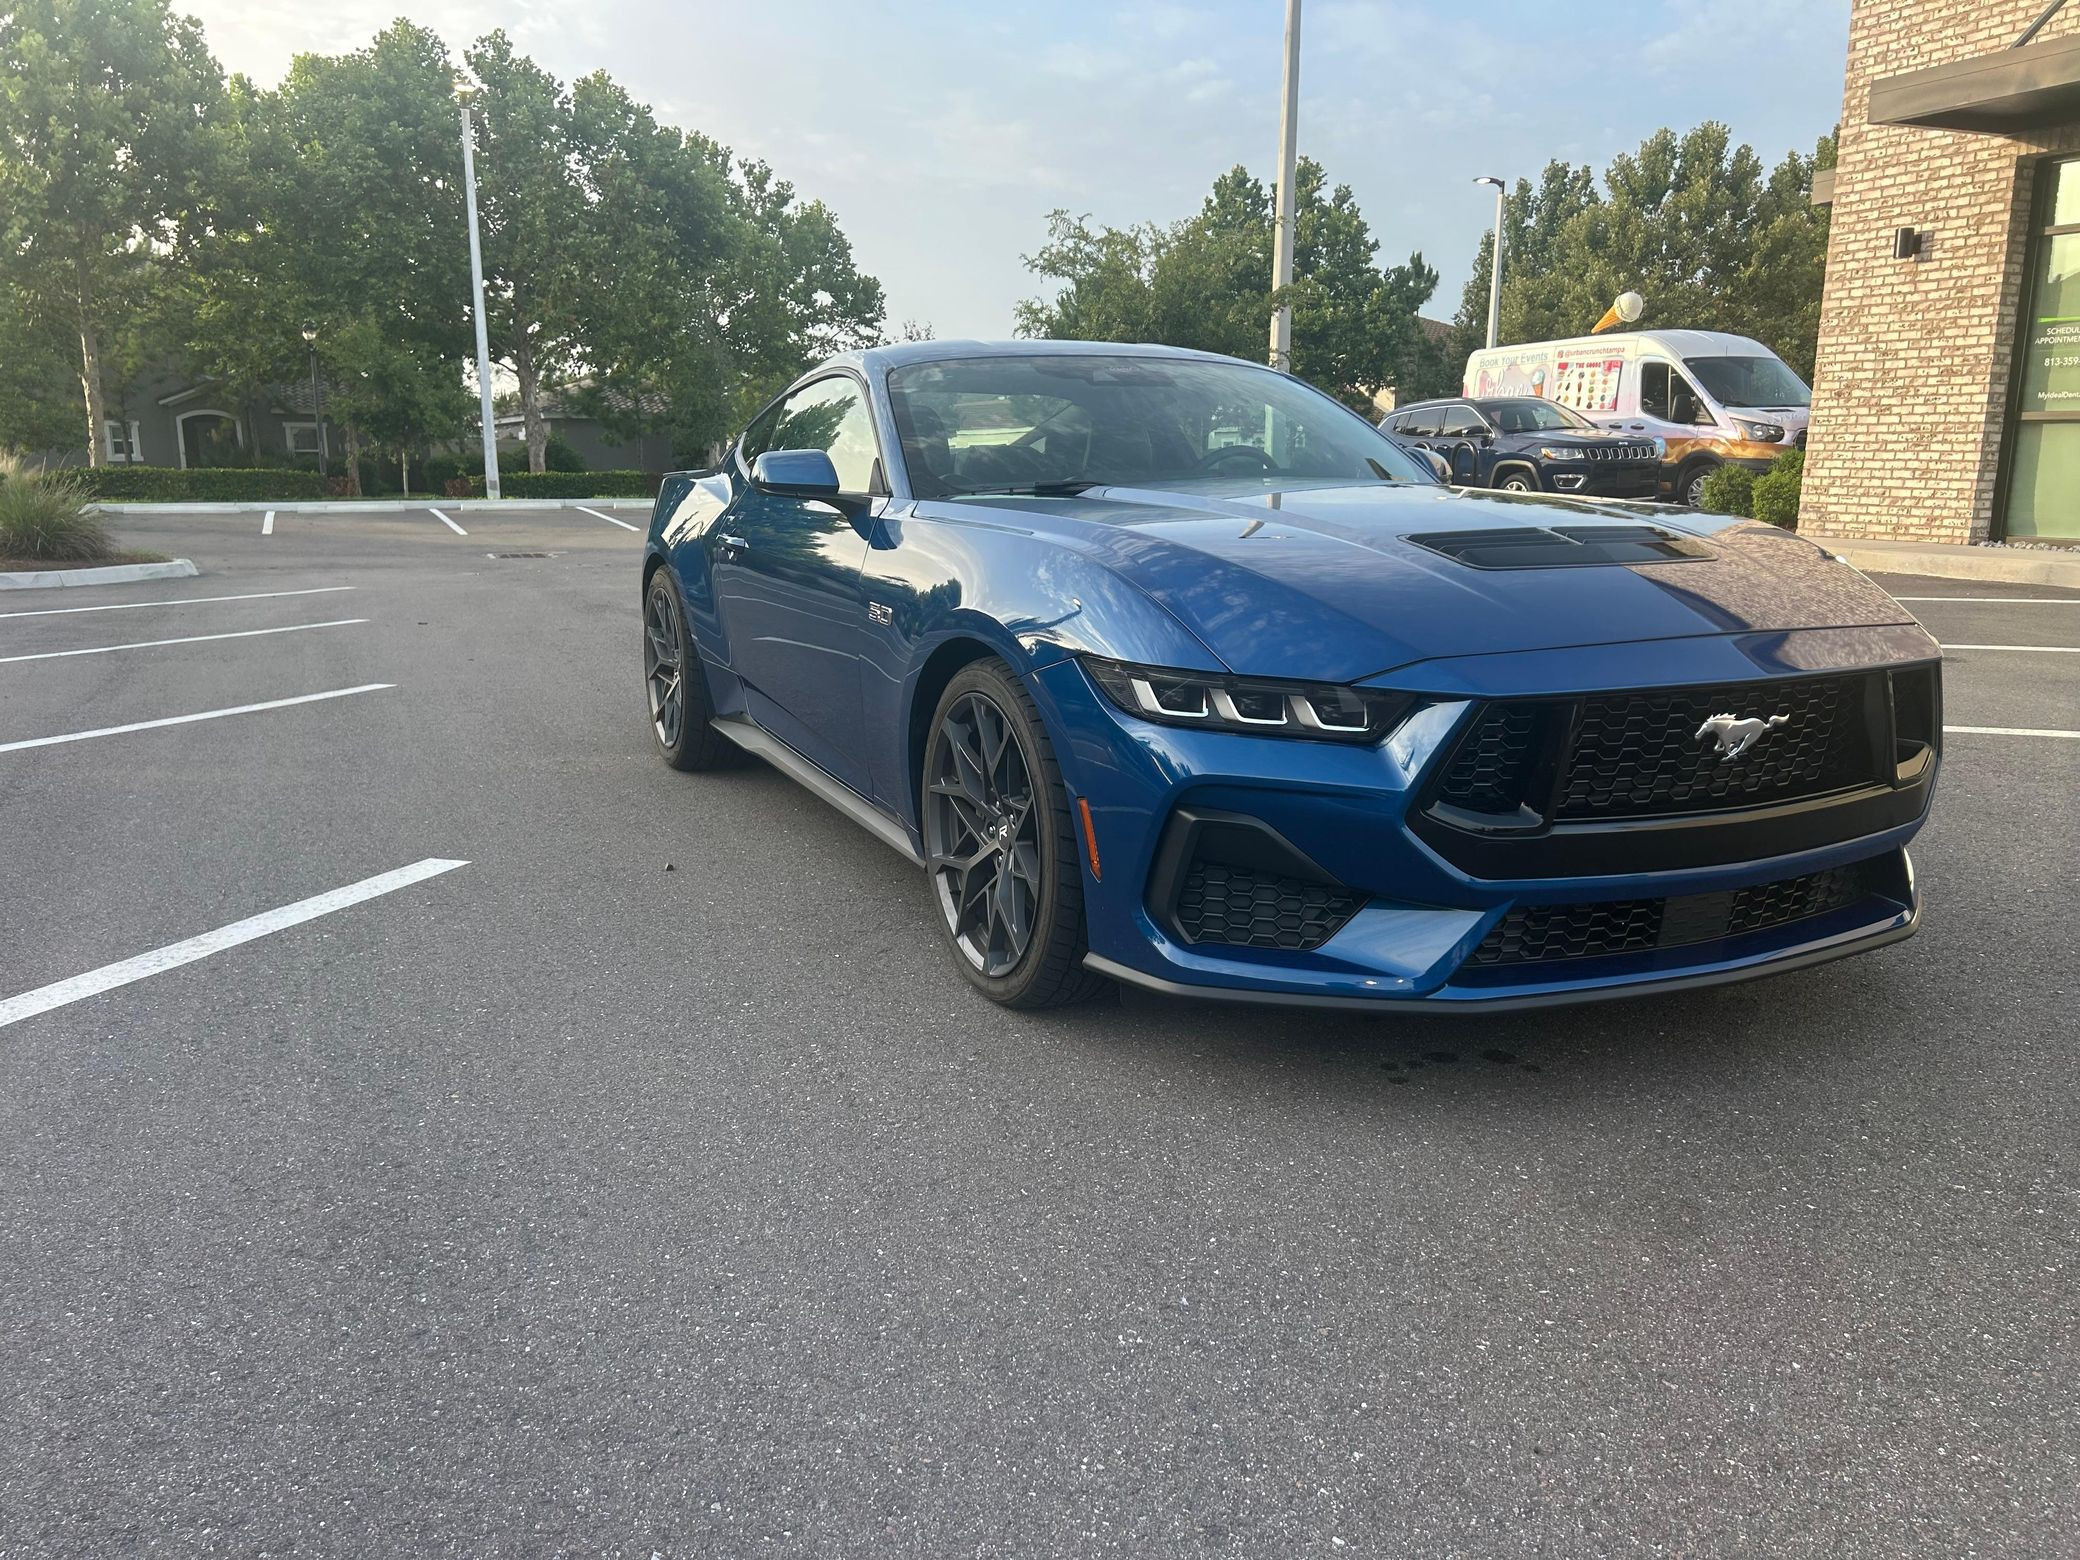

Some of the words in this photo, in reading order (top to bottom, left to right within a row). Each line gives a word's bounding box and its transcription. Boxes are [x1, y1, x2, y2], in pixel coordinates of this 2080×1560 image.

[1479, 358, 1499, 368] Book
[1502, 355, 1520, 365] Your
[1521, 351, 1549, 363] Events
[2037, 391, 2080, 400] MyIdealDent
[999, 824, 1008, 841] R
